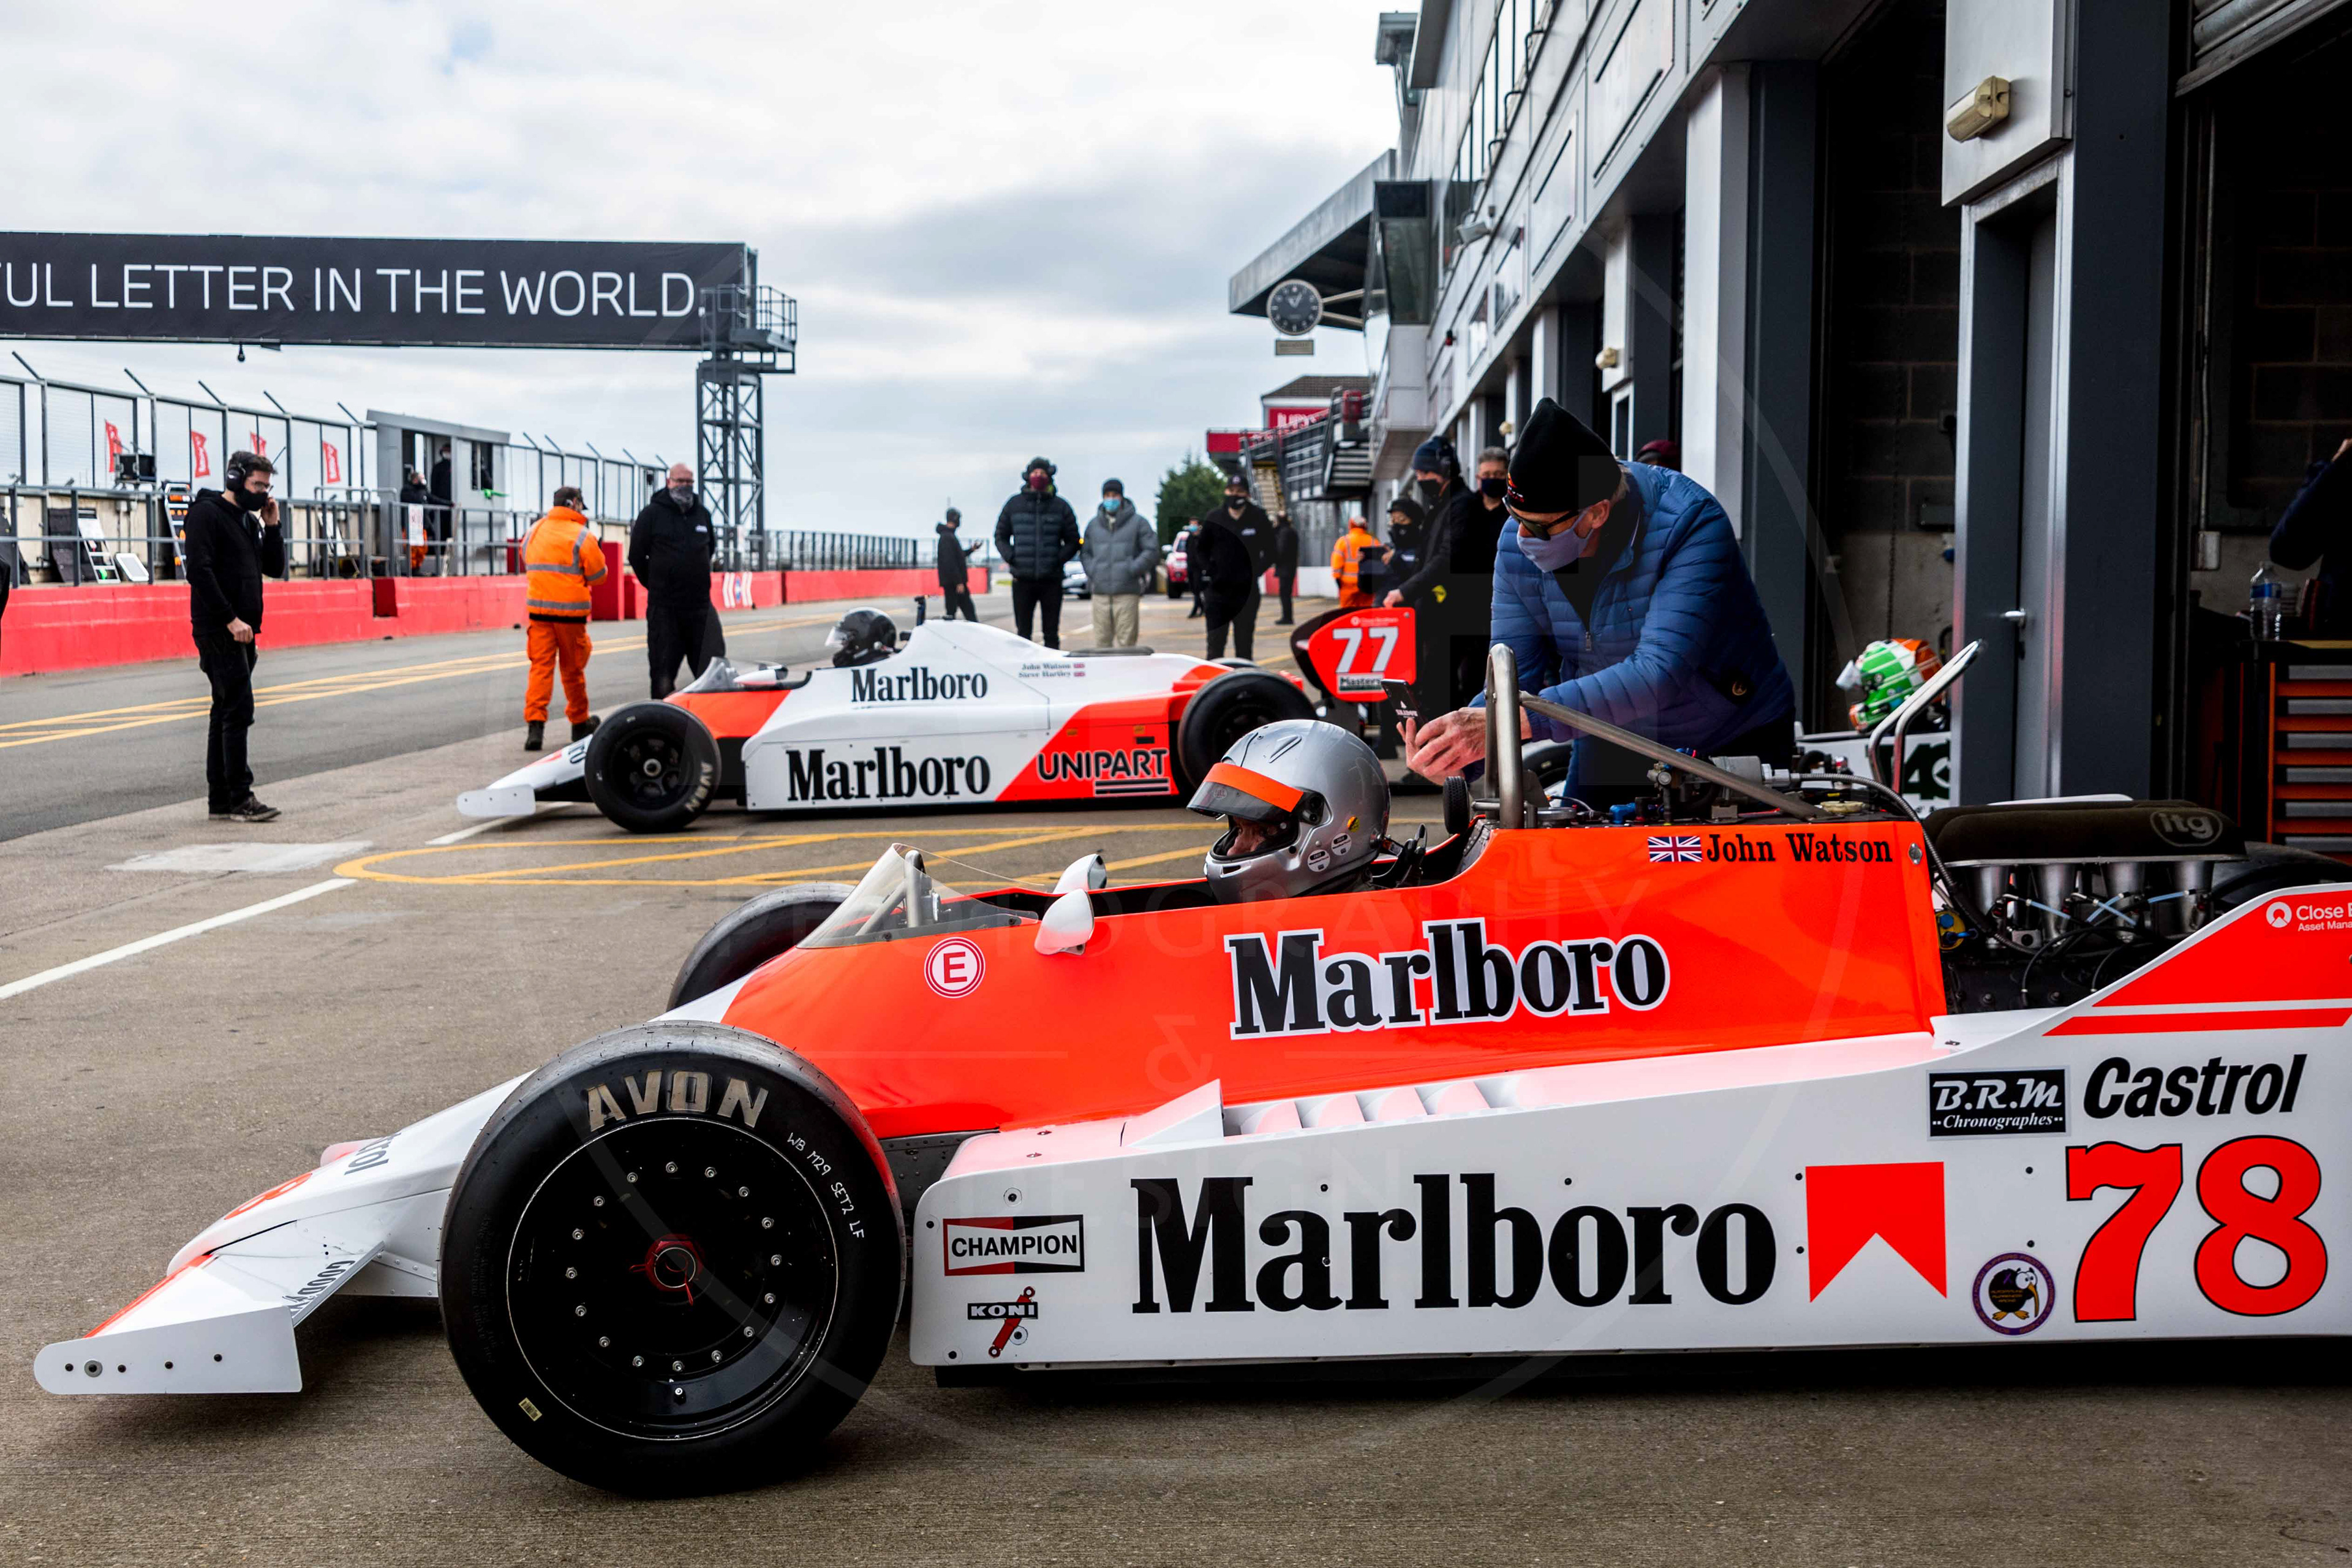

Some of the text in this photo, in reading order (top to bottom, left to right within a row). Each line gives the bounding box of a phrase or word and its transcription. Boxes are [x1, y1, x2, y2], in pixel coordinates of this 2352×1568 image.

[0, 262, 74, 307] UL
[91, 263, 295, 311] LETTER
[315, 267, 361, 312] IN
[376, 268, 486, 315] THE
[1333, 627, 1398, 673] 77
[851, 666, 988, 703] Marlboro
[786, 746, 990, 801] Marlboro
[1036, 748, 1169, 782] UNIPART
[2158, 812, 2212, 839] itg
[1707, 833, 1893, 862] John Watson
[2296, 905, 2344, 921] Close
[2298, 922, 2324, 931] Asset
[943, 951, 968, 984] E
[1225, 919, 1668, 1039] Marlboro
[586, 1069, 769, 1133] AVON
[2083, 1054, 2308, 1119] Castrol
[787, 1132, 806, 1152] WB
[807, 1150, 832, 1176] M29
[849, 1219, 865, 1238] LF
[951, 1234, 1077, 1257] CHAMPION
[1130, 1172, 1777, 1314] Marlboro
[2065, 1134, 2329, 1324] 78
[971, 1305, 1035, 1317] KONI
